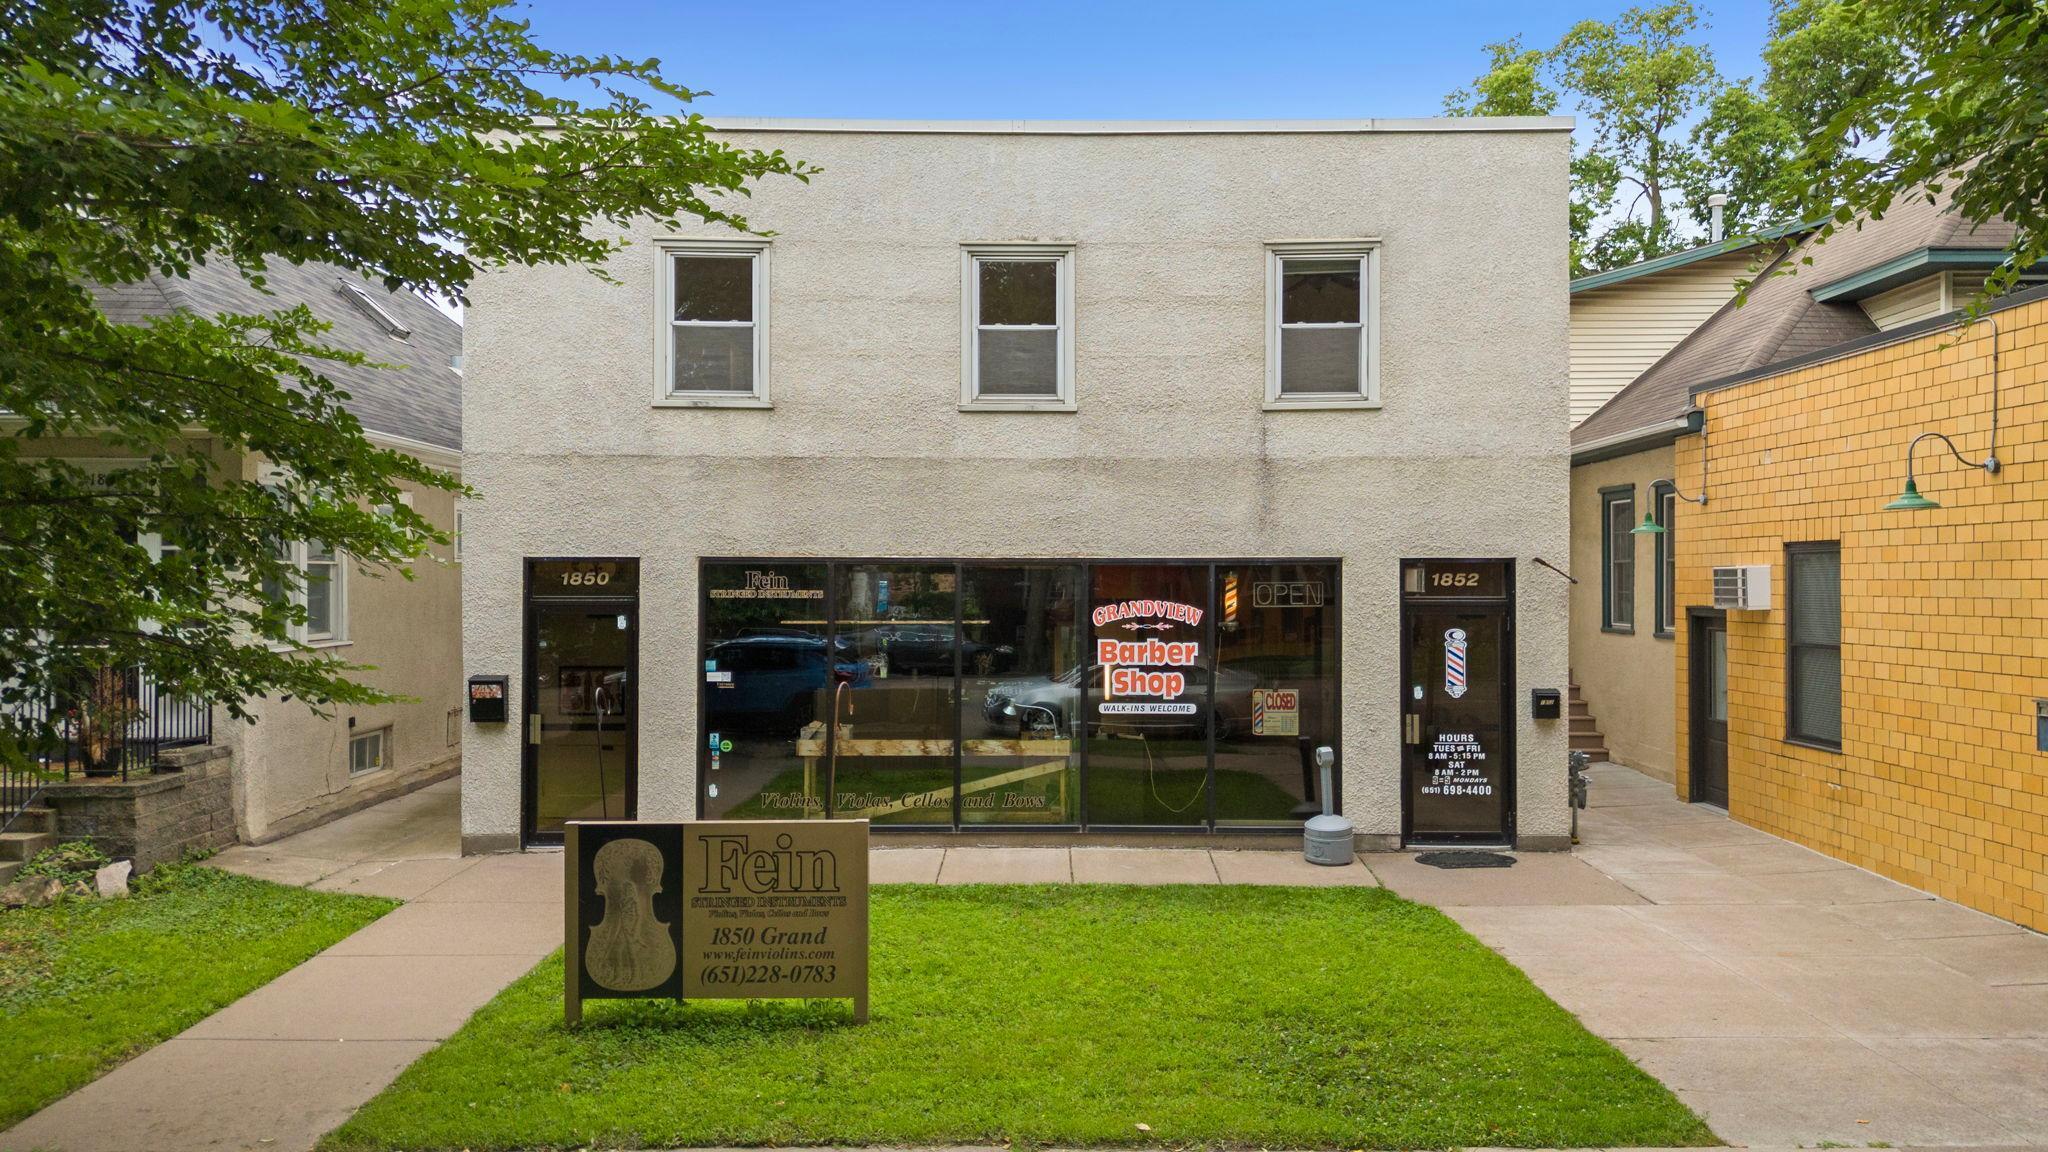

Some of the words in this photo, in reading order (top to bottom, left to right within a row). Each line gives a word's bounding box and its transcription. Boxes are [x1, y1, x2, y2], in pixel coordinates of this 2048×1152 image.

[561, 572, 610, 586] 1850
[744, 570, 789, 590] Fein
[1431, 572, 1480, 587] 1852
[1255, 584, 1321, 606] OPEN
[1092, 599, 1203, 627] GRANDVIEW
[1097, 638, 1199, 666] Barber
[1112, 668, 1185, 700] Shop
[1103, 704, 1146, 713] WALK-INS
[1150, 704, 1192, 713] WELCOME
[1266, 692, 1296, 710] CLOSED
[1439, 734, 1474, 742] HOURS
[1448, 761, 1465, 769] SAT
[1421, 786, 1440, 794] (651)
[760, 792, 824, 809] Violins,
[836, 792, 893, 809] Violas,
[900, 792, 950, 808] Cellos
[962, 792, 996, 808] and
[1002, 792, 1046, 808] Bows
[698, 833, 840, 894] Fein
[690, 896, 755, 908] STRINGED
[757, 896, 848, 908] INSTRUMENTS
[710, 926, 755, 946] 1850
[760, 926, 828, 945] Grand
[702, 947, 835, 963] www.feinviolins.com
[700, 964, 836, 986] (651)228-0783
